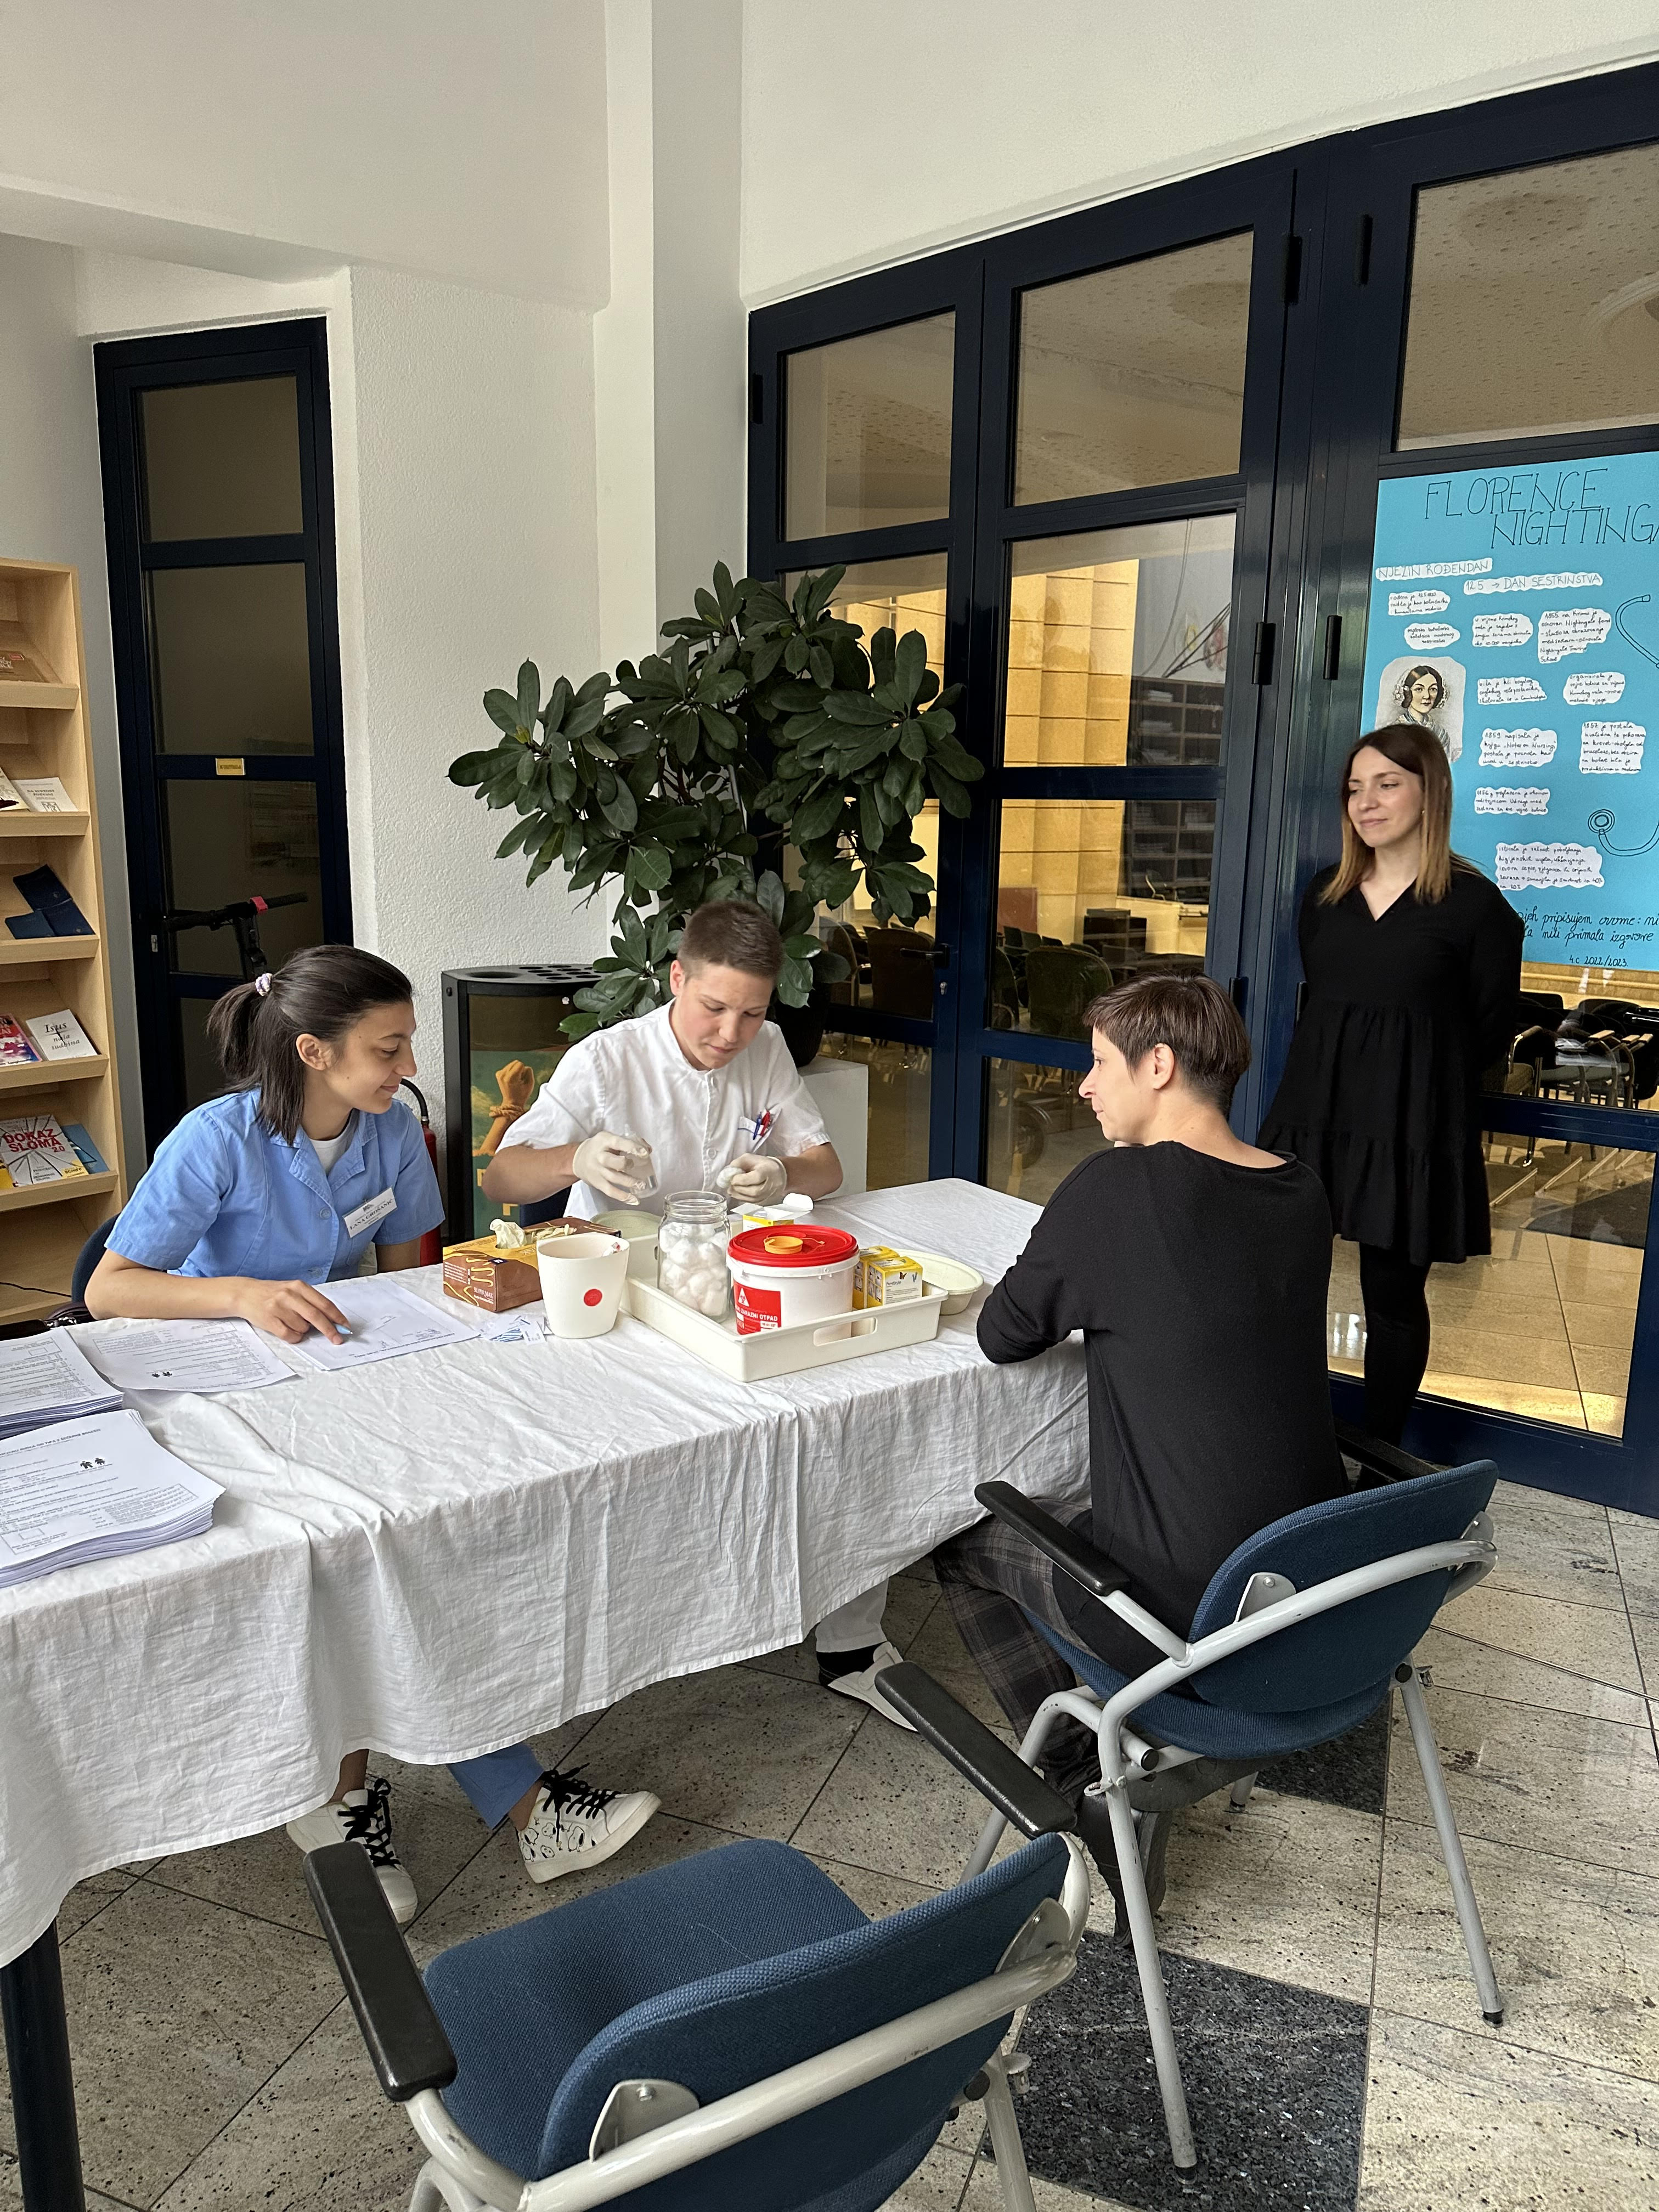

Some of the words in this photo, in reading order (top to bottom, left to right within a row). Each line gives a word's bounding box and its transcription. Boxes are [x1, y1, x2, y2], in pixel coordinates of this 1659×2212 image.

[1425, 468, 1608, 519] FLORENCE
[1491, 504, 1659, 548] NIGHTING
[1426, 561, 1489, 576] ROĐENDAN
[1504, 576, 1526, 590] DAN
[1531, 574, 1601, 588] SESTRINSTVA
[1592, 610, 1598, 618] je
[1600, 724, 1607, 732] je
[1609, 721, 1633, 732] postala
[1505, 732, 1532, 742] napisala
[1533, 732, 1540, 741] je
[1483, 750, 1504, 758] postala
[1541, 912, 1593, 932] pripisujem
[1542, 927, 1560, 939] niti
[1565, 928, 1604, 947] primala
[1610, 930, 1654, 949] izgovore
[44, 1023, 67, 1033] Isus
[2, 1128, 54, 1144] DOKAZ
[8, 1137, 62, 1153] SLOMA
[349, 1218, 366, 1231] LANA
[741, 1308, 759, 1319] ZARAZNI
[759, 1313, 778, 1322] OTPAD
